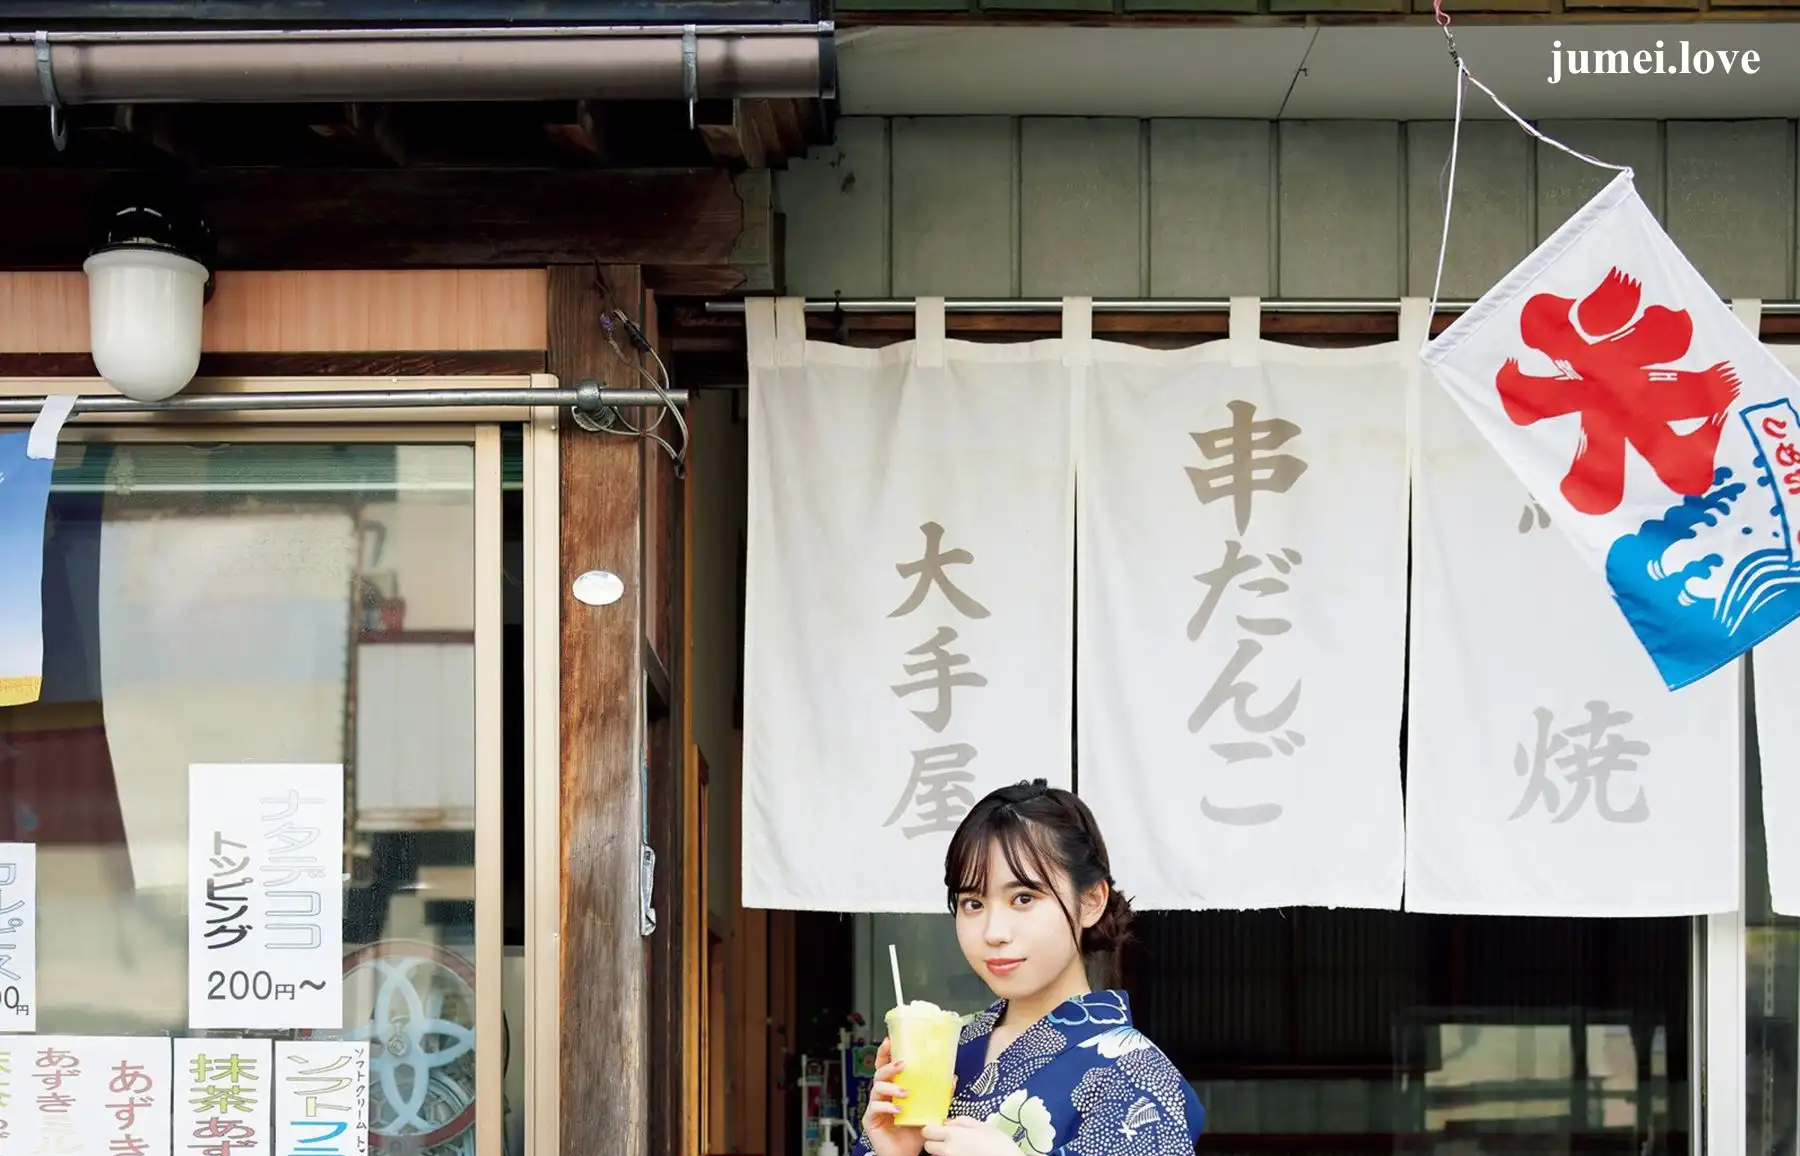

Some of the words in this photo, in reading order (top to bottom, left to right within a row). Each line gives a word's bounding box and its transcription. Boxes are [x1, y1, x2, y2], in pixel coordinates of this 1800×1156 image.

[882, 521, 991, 840] 大手屋
[1182, 400, 1309, 826] 串だんご
[204, 831, 253, 949] トッピング
[259, 789, 326, 949] ナタデココ
